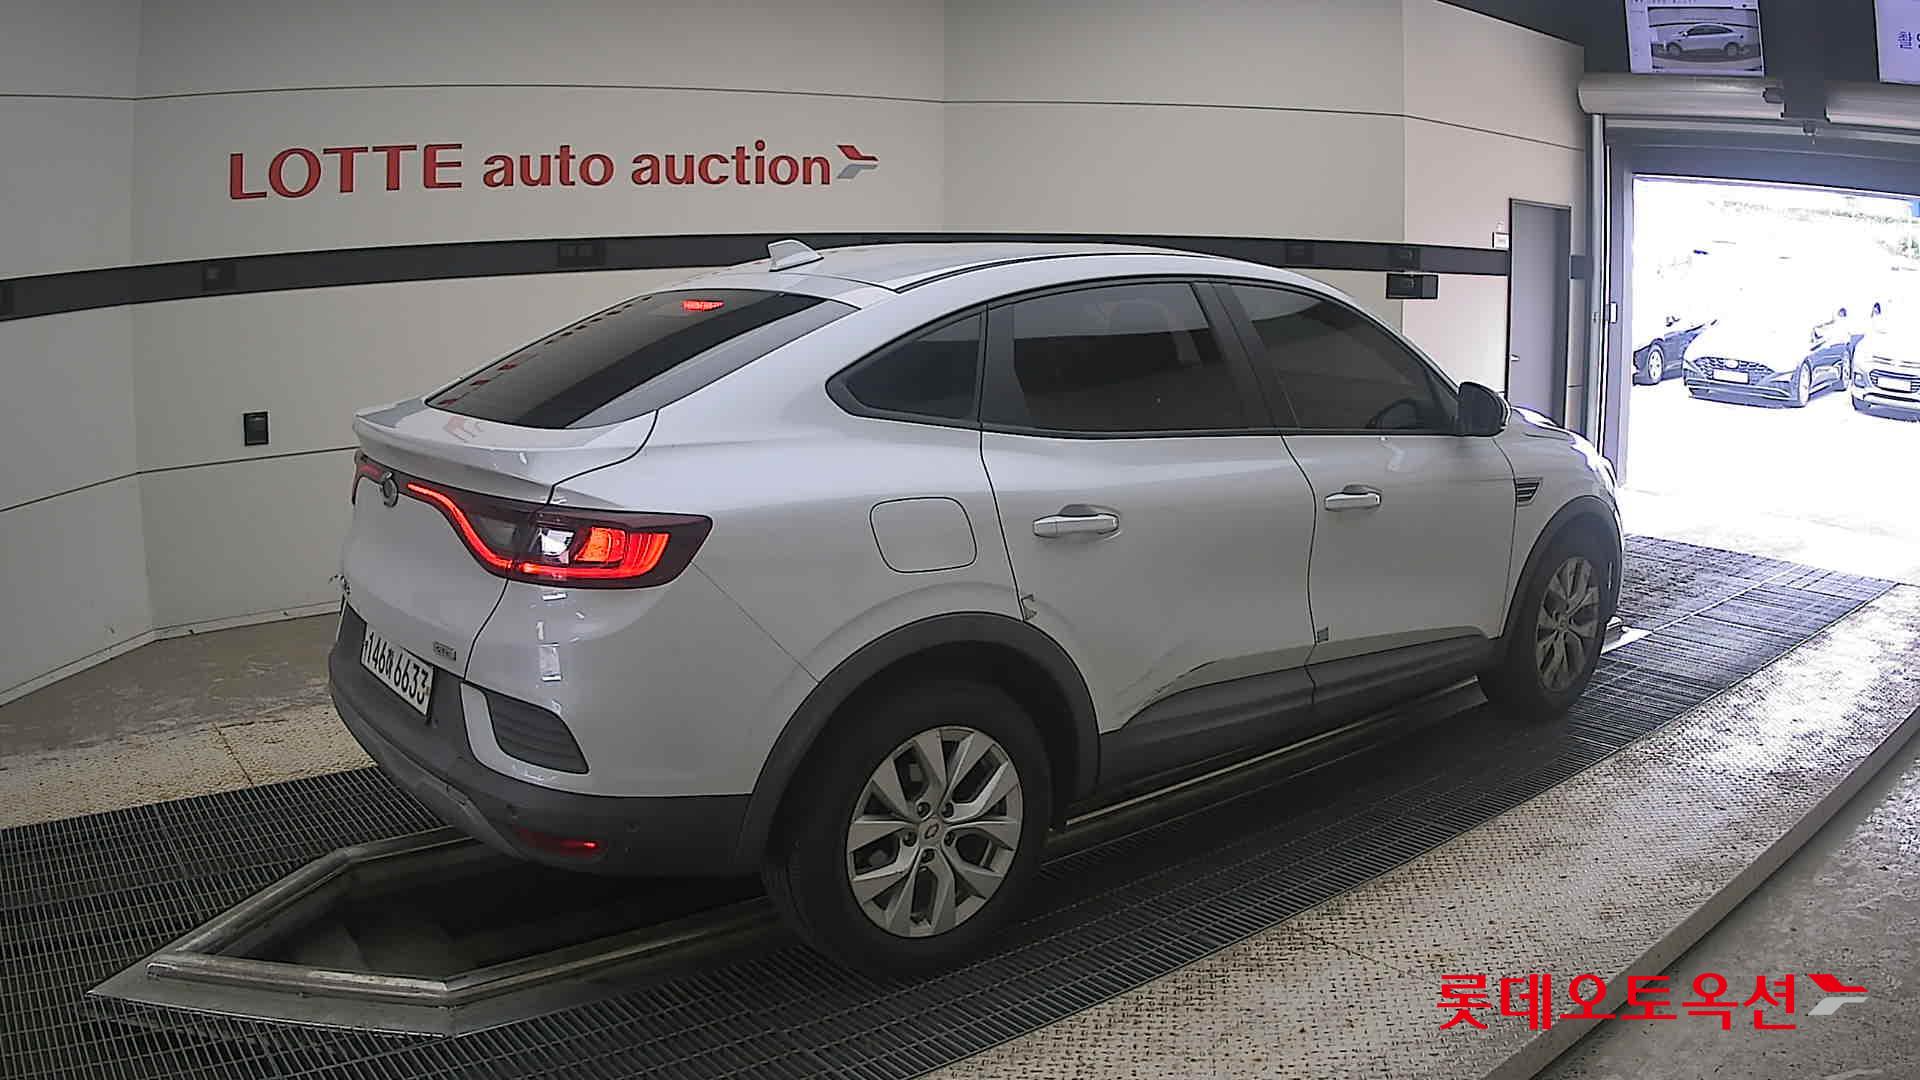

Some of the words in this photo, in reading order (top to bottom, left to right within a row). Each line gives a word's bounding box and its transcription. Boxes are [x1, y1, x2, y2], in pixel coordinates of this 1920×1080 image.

[230, 143, 464, 200] LOTTE
[482, 144, 615, 188] auto
[630, 139, 832, 187] auction
